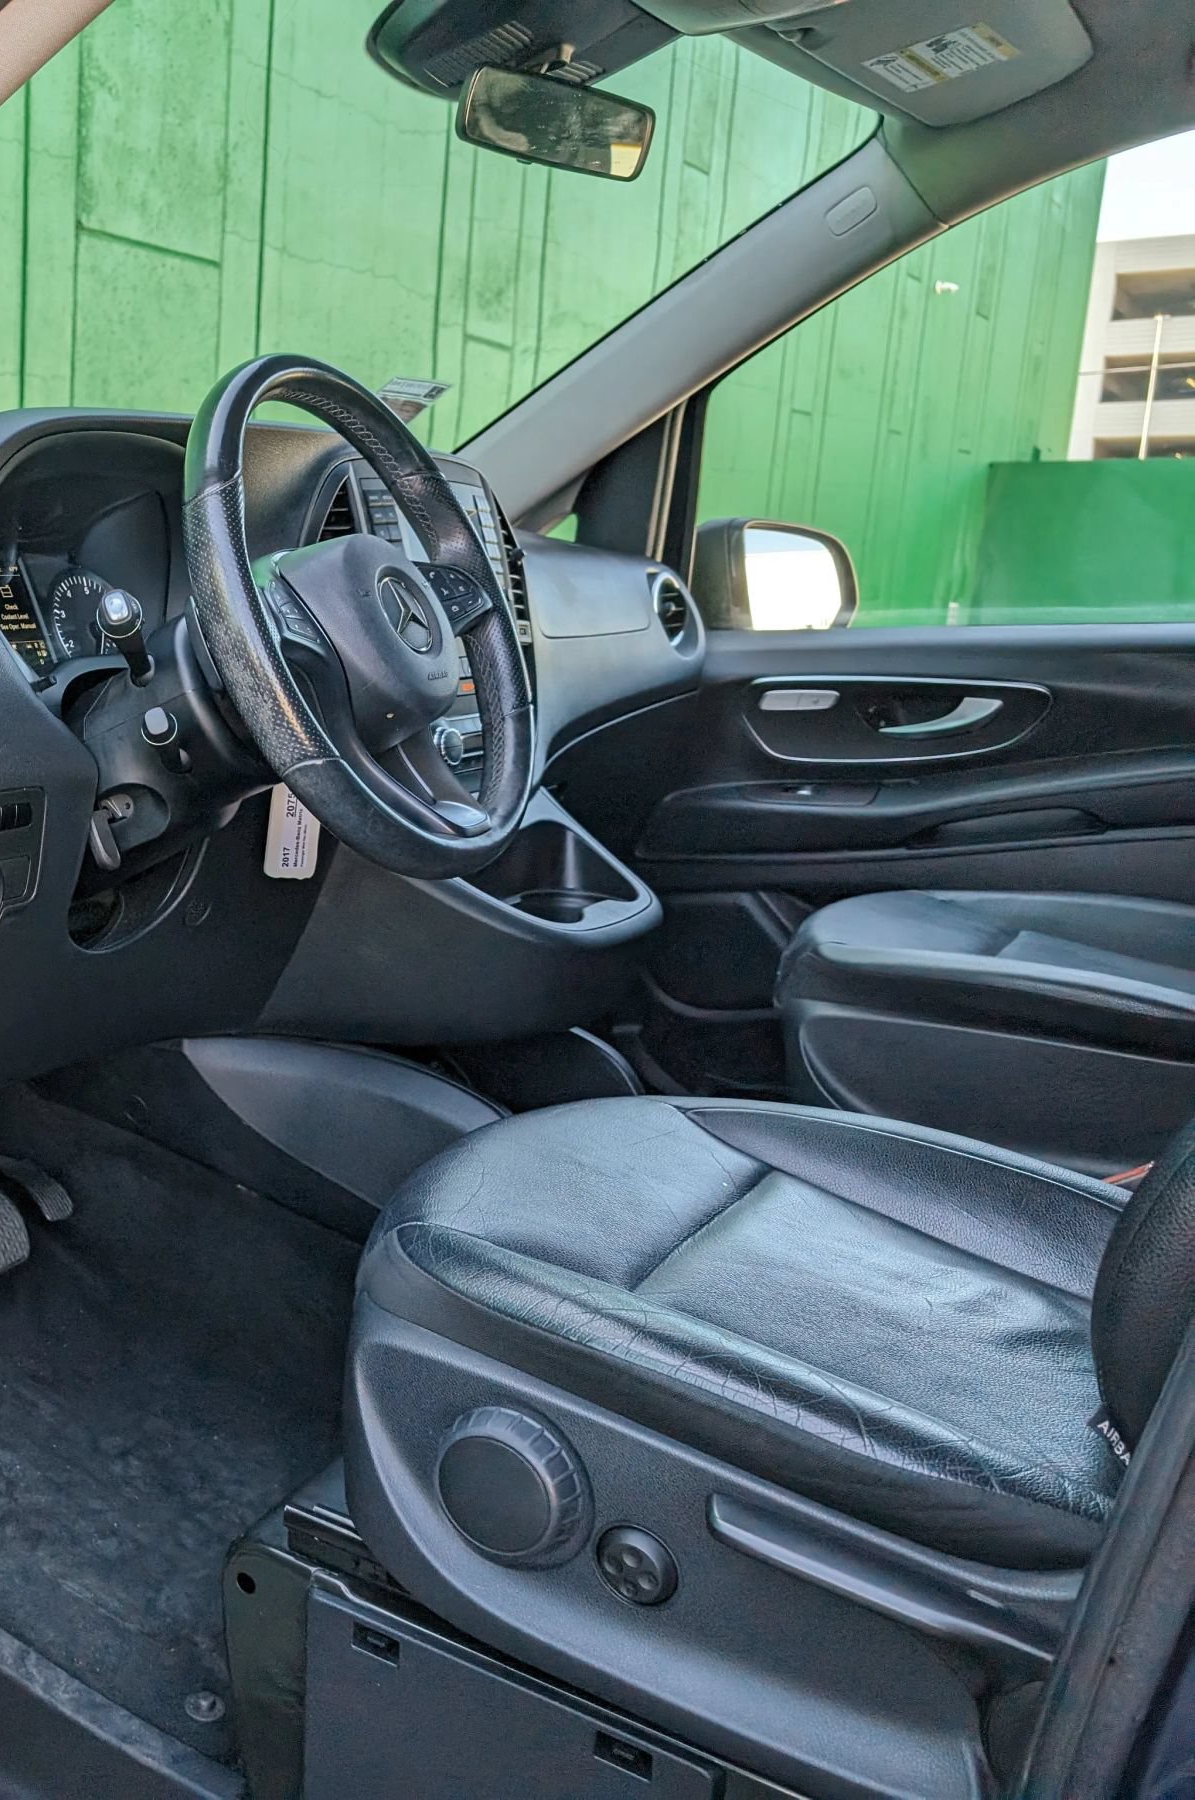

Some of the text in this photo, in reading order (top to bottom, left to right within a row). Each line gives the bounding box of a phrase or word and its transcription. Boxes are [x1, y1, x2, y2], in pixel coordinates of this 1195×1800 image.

[66, 590, 72, 598] 4
[84, 586, 90, 595] 5
[4, 603, 19, 611] Check
[68, 639, 75, 648] 2
[293, 826, 302, 868] Mercedes-Benz
[282, 847, 290, 867] 2017
[1097, 1420, 1131, 1466] AIRBA
